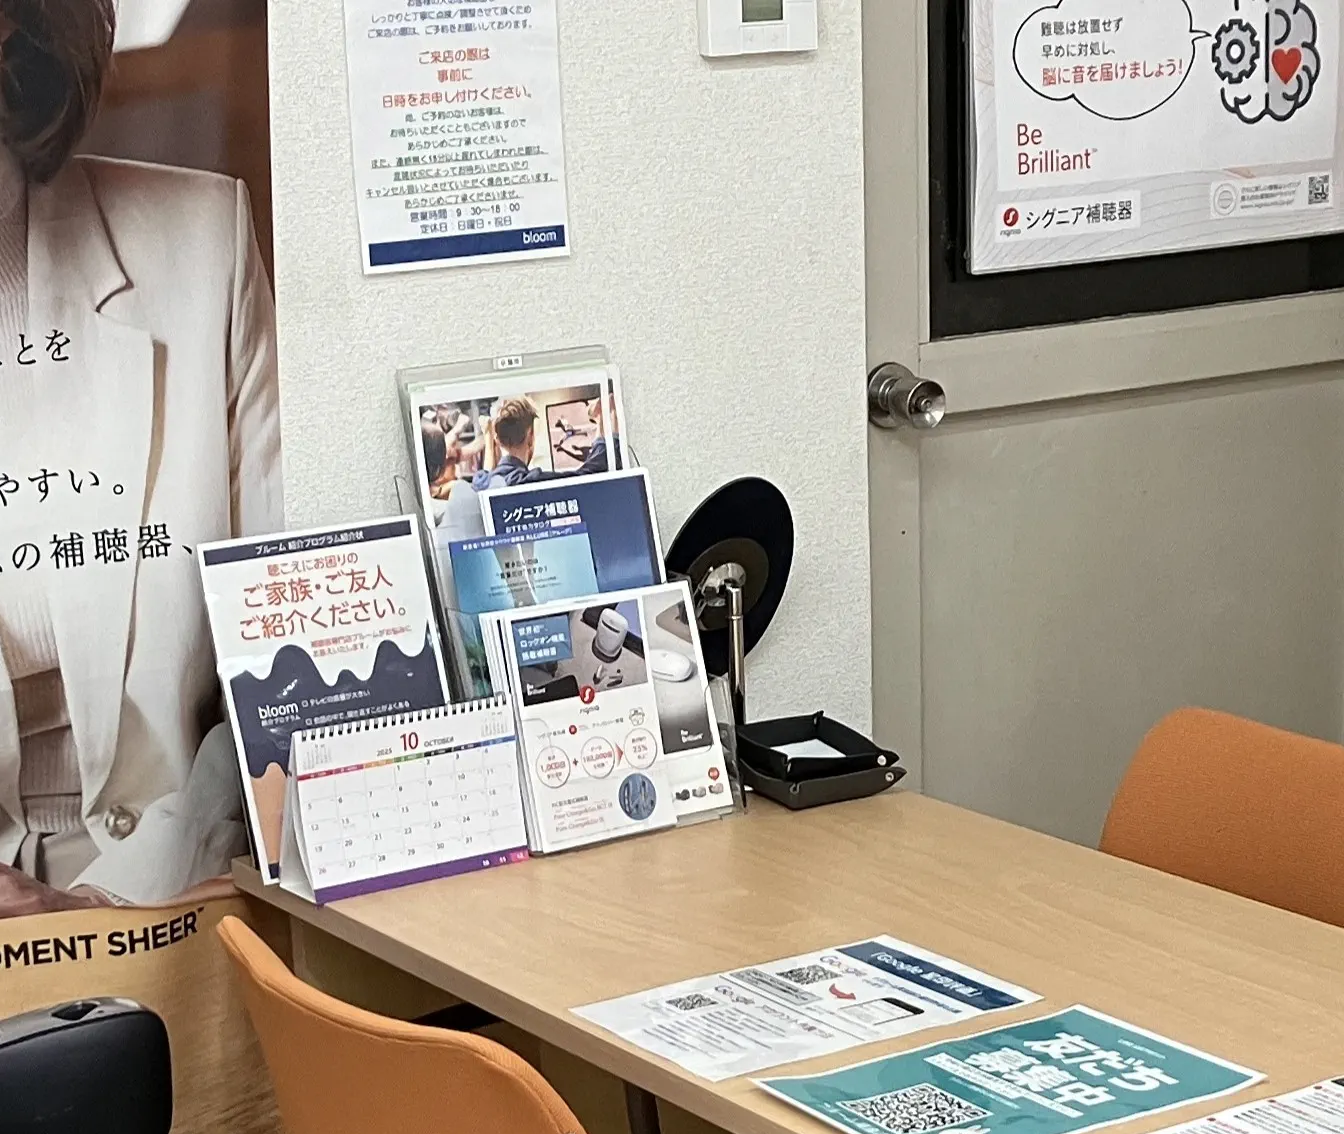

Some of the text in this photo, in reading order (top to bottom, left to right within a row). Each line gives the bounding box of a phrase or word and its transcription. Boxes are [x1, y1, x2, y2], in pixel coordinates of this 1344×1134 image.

[1041, 17, 1124, 37] 難聴は放置せず
[418, 47, 490, 65] ご来店の際は
[437, 68, 473, 83] 事前に
[382, 85, 532, 109] 日時をお申し付けください。
[1017, 123, 1043, 146] Be
[1026, 200, 1132, 229] シグニア補聴器
[523, 230, 557, 244] bloom
[267, 552, 358, 577] 聴こえにお困りの
[244, 564, 393, 608] ご家族・ご友人
[240, 597, 406, 640] ご紹介ください。
[257, 701, 299, 720] bloom
[400, 732, 419, 751] 10
[1023, 1032, 1180, 1092] 友だち
[964, 1047, 1117, 1107] 募集中
